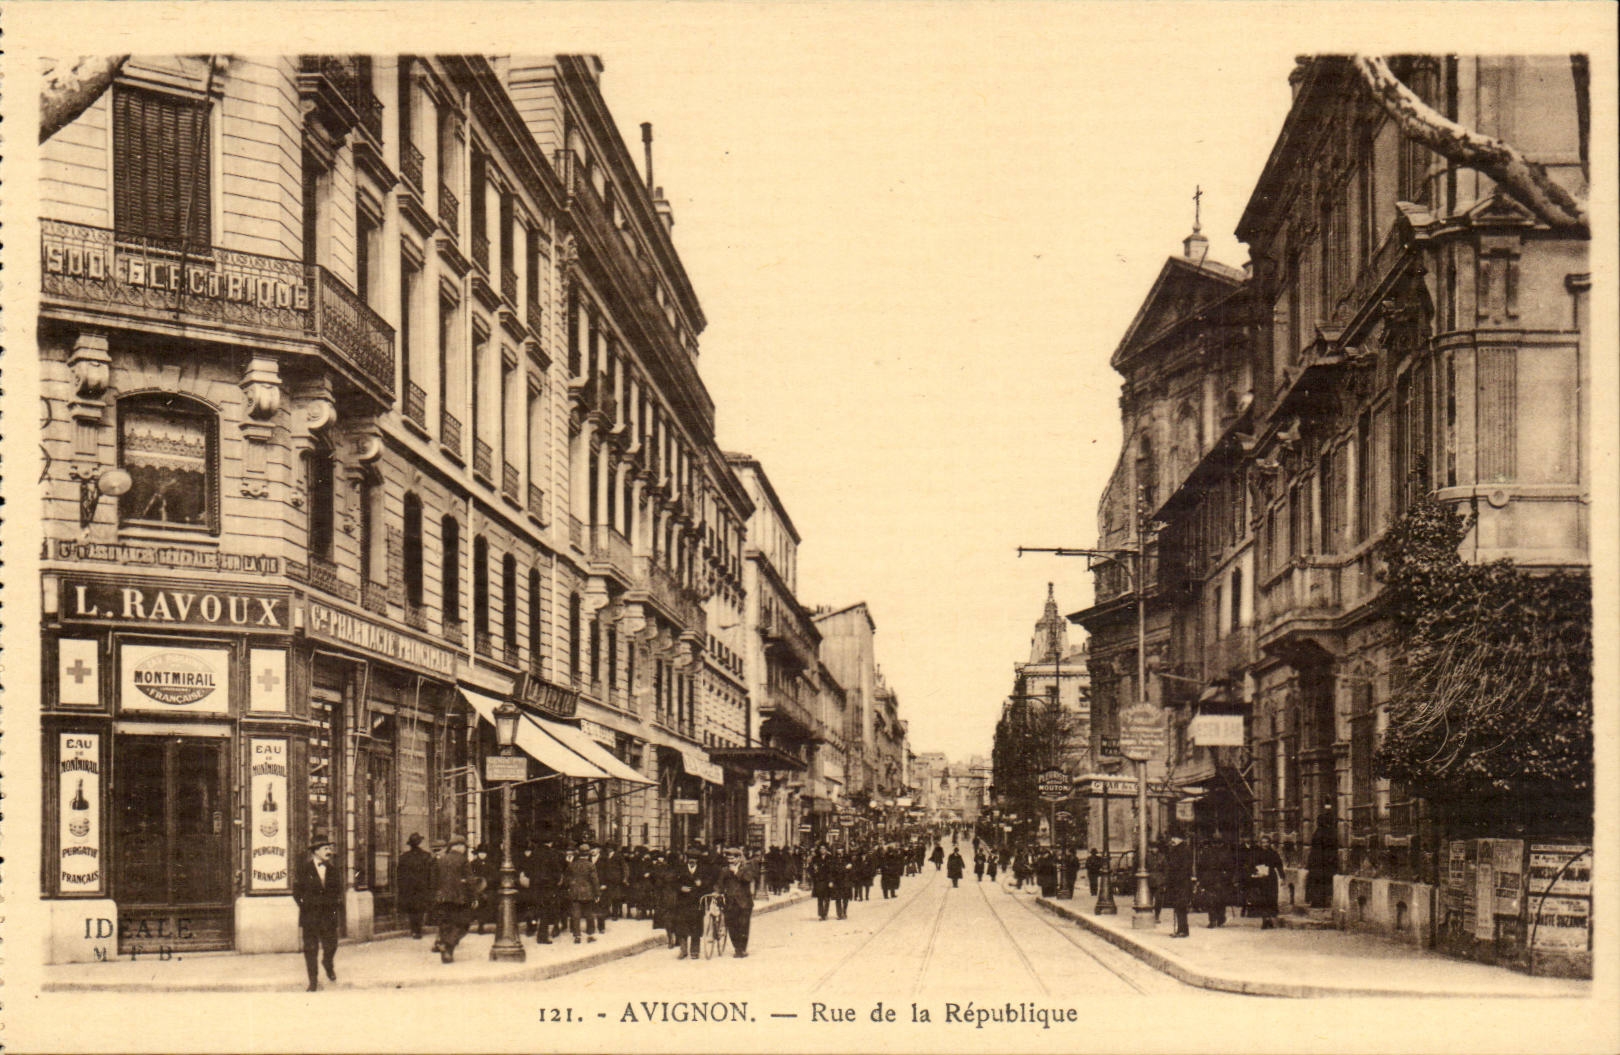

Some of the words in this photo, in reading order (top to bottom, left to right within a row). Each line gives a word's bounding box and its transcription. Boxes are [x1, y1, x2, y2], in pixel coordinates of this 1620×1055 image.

[75, 585, 113, 618] L.
[121, 587, 281, 627] RAVOUX
[134, 669, 216, 687] MONTMIRAIL
[149, 688, 203, 704] FRANÇAISE
[66, 738, 92, 749] EAU
[255, 744, 282, 754] EAU
